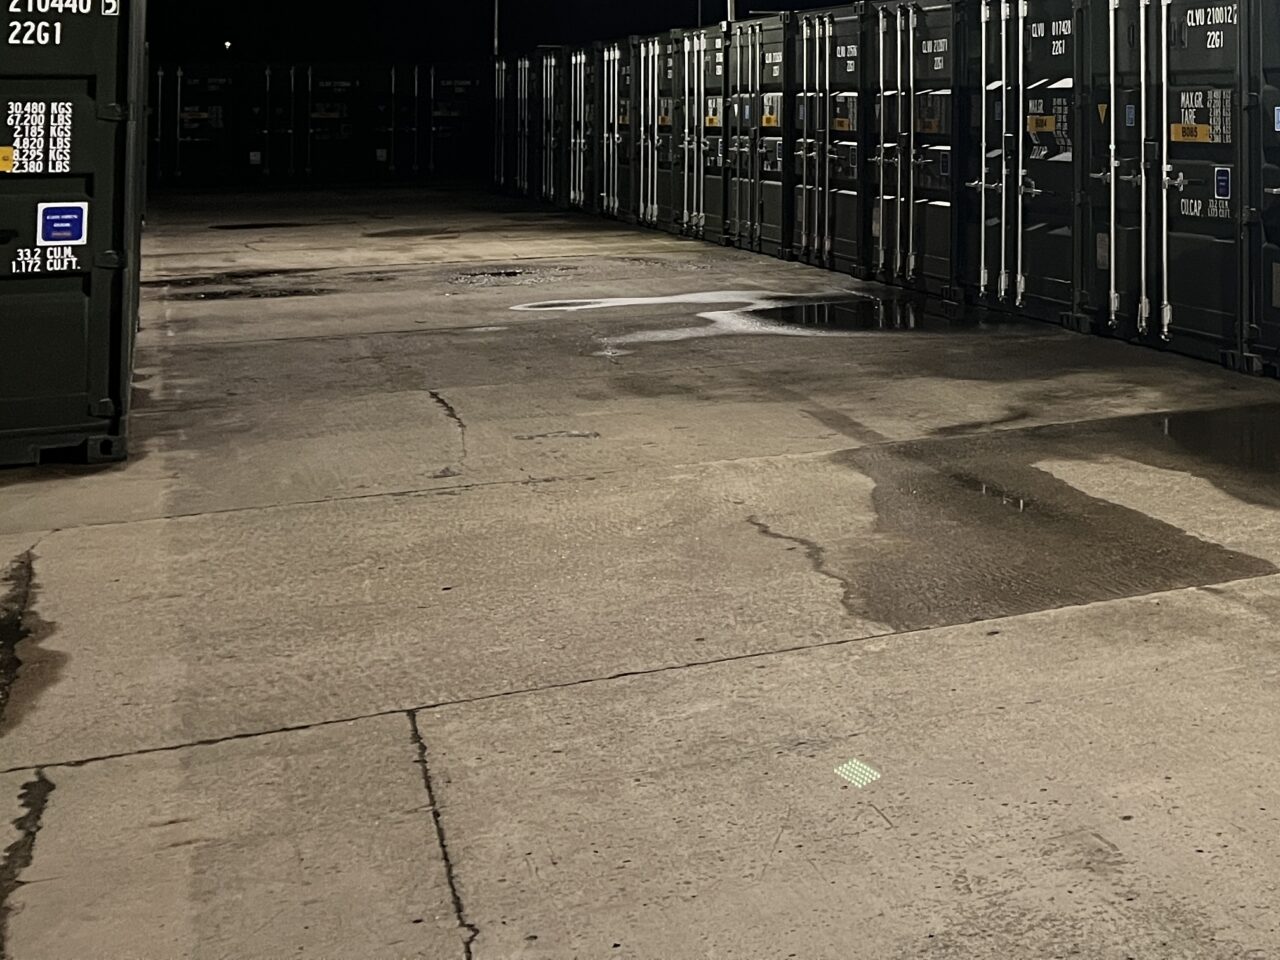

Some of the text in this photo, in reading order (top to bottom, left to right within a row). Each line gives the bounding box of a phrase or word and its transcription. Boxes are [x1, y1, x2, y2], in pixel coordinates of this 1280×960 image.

[1187, 8, 1204, 27] CLVU
[1207, 6, 1232, 25] 210012
[8, 21, 61, 45] 22G1
[1207, 31, 1223, 49] 22G1
[50, 102, 73, 114] KGS
[50, 114, 72, 126] LBS
[49, 126, 72, 138] KGS
[49, 137, 71, 149] LBS
[48, 149, 71, 161] KGS
[48, 161, 70, 173] LBS
